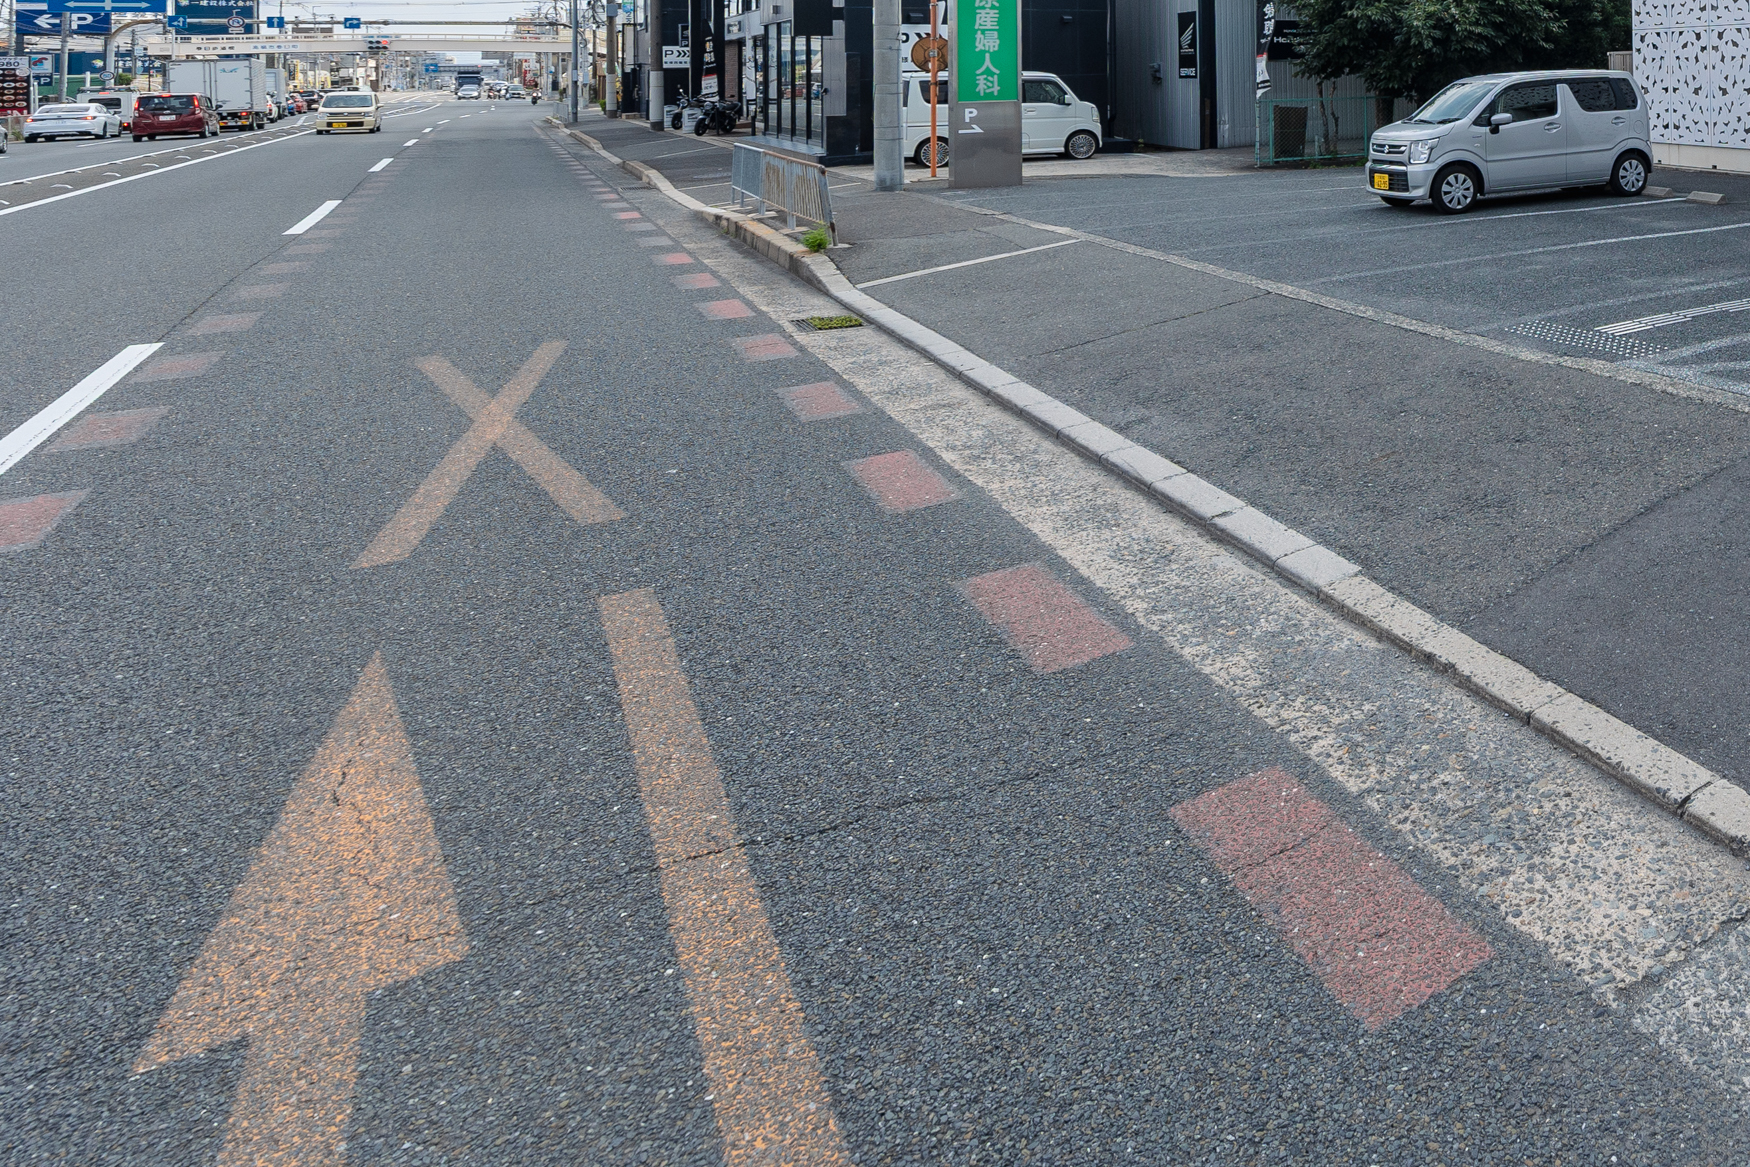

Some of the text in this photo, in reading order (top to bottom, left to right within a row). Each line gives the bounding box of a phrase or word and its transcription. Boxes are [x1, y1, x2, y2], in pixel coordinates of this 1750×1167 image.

[71, 13, 94, 30] P
[664, 49, 674, 58] P
[964, 108, 978, 123] P
